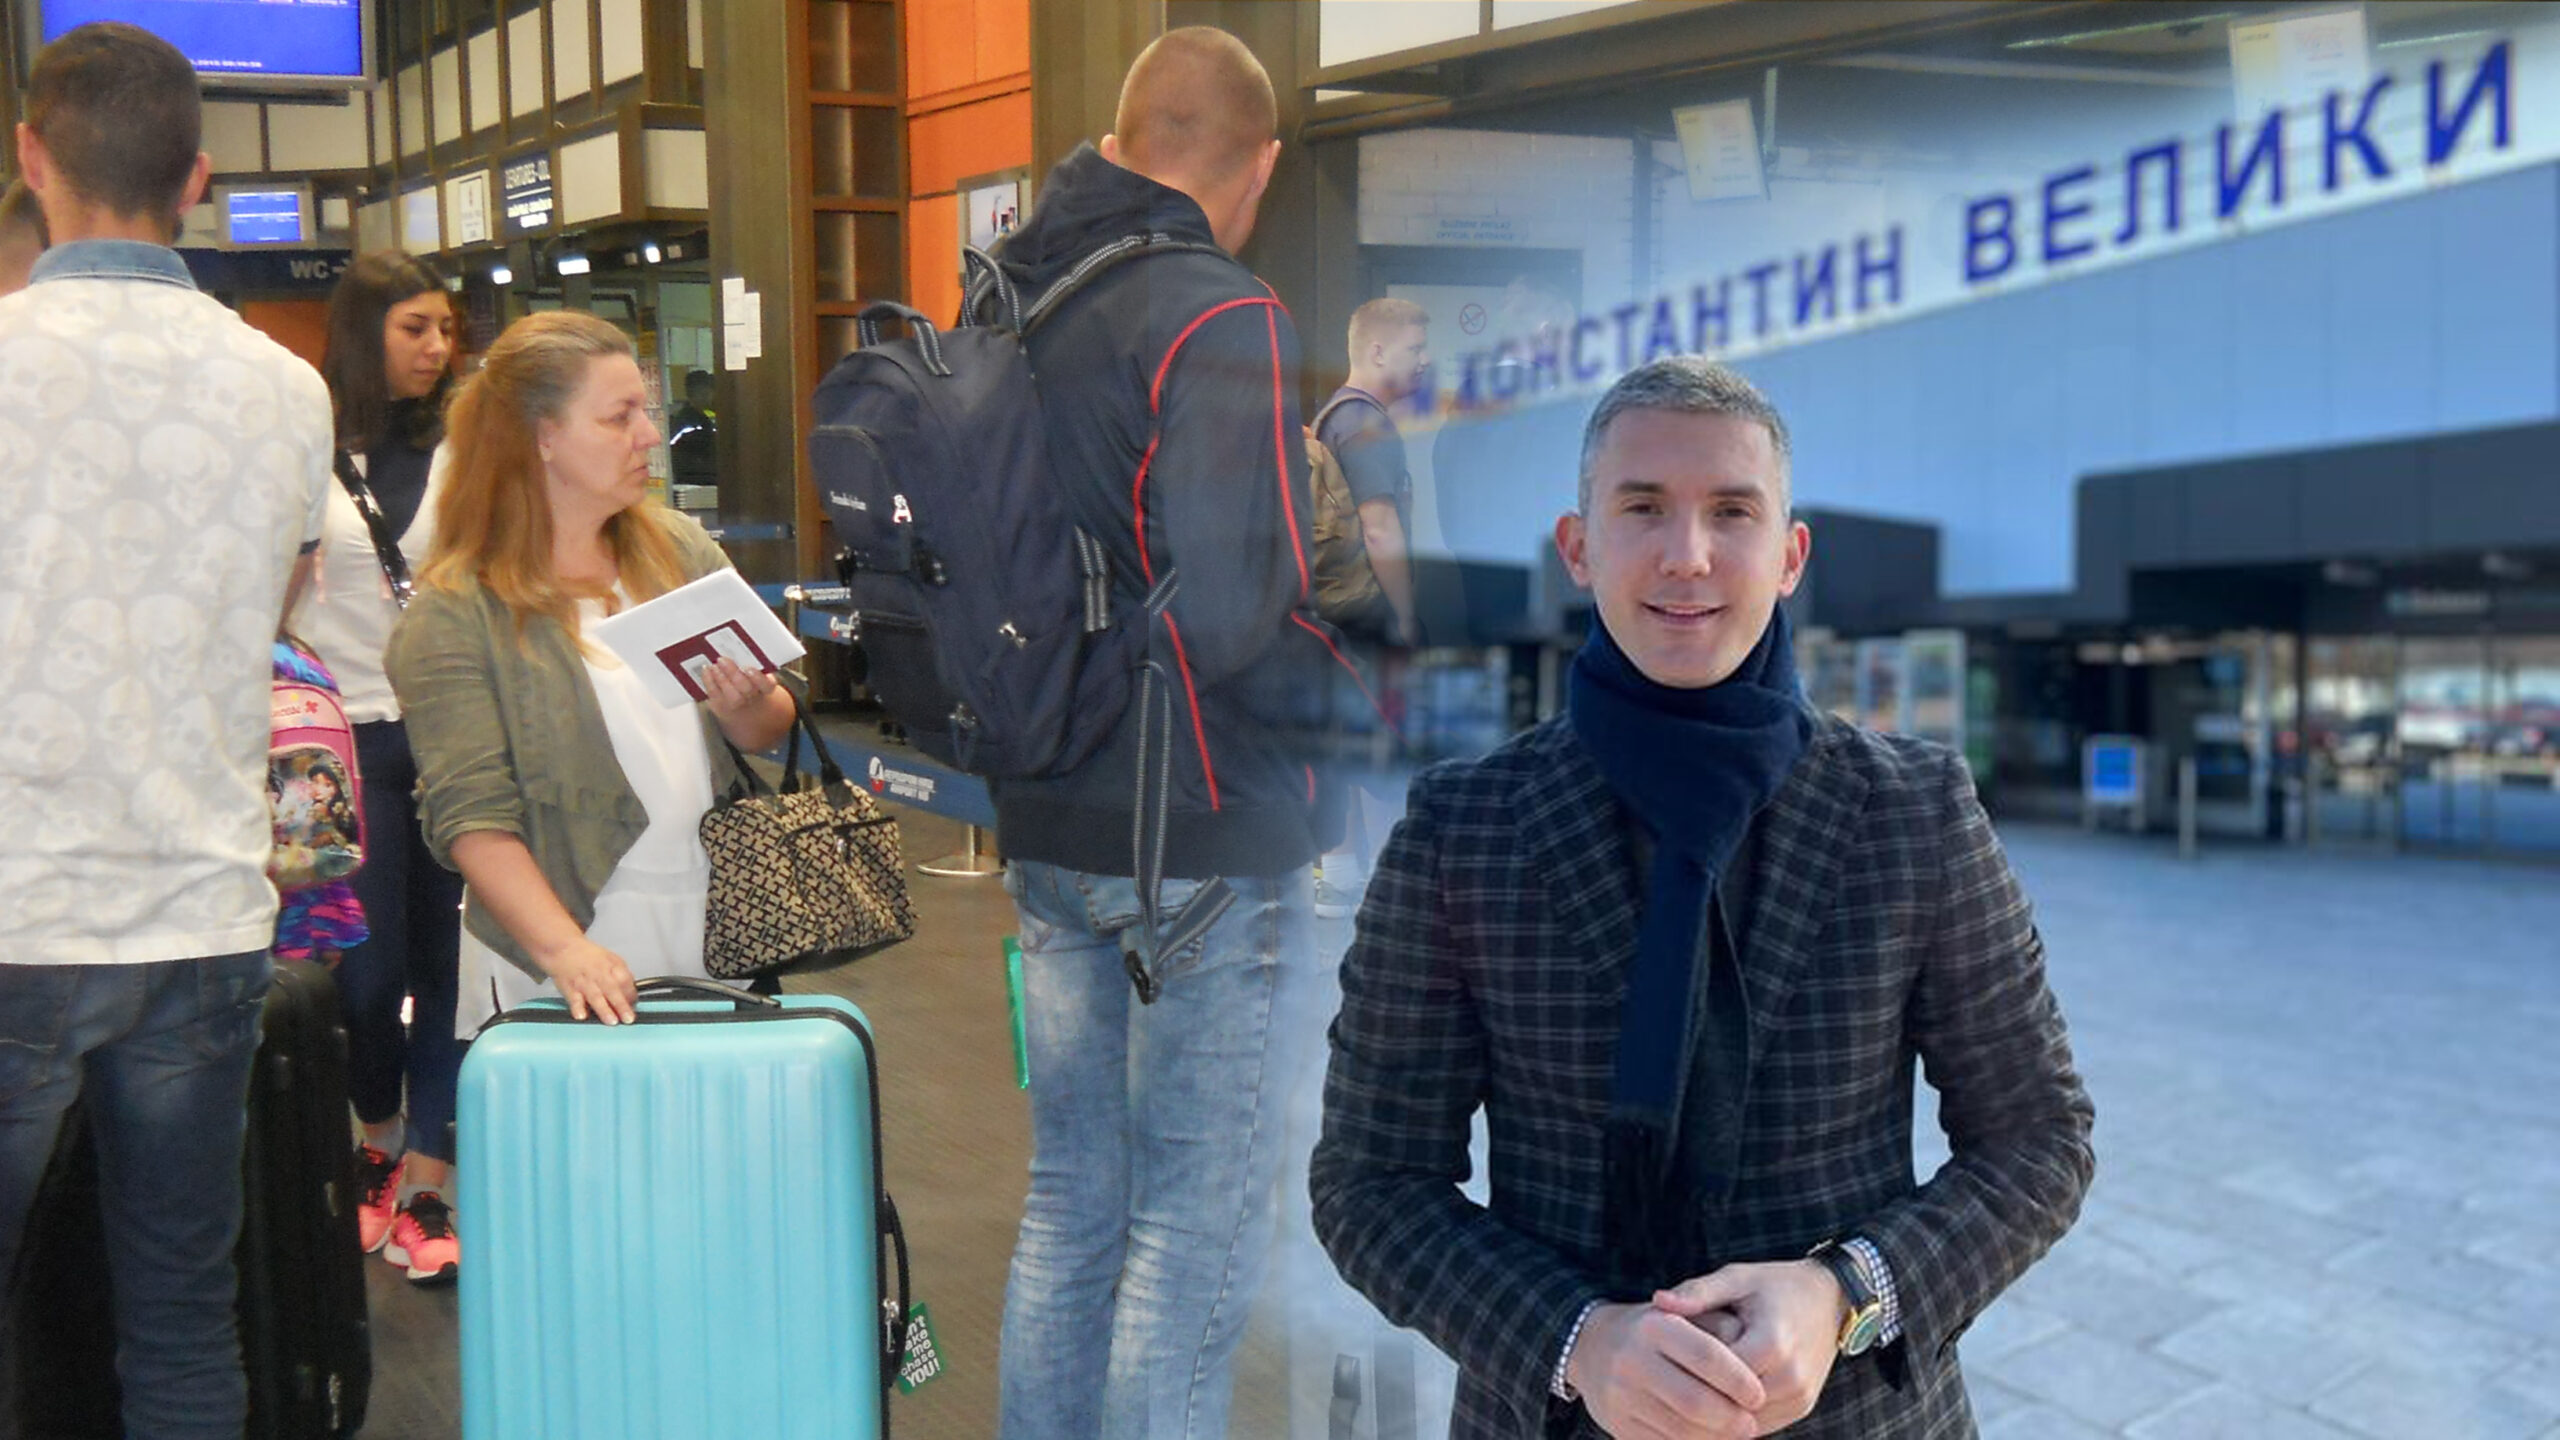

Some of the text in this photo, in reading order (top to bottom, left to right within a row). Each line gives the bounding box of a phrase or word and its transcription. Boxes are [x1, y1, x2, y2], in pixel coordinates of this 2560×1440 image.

[1962, 38, 2515, 285] ВЕЛИКИ
[290, 260, 329, 279] WC
[905, 1329, 928, 1351] ake
[911, 1339, 932, 1358] me
[901, 1349, 936, 1377] chase
[905, 1357, 941, 1388] YOU!
